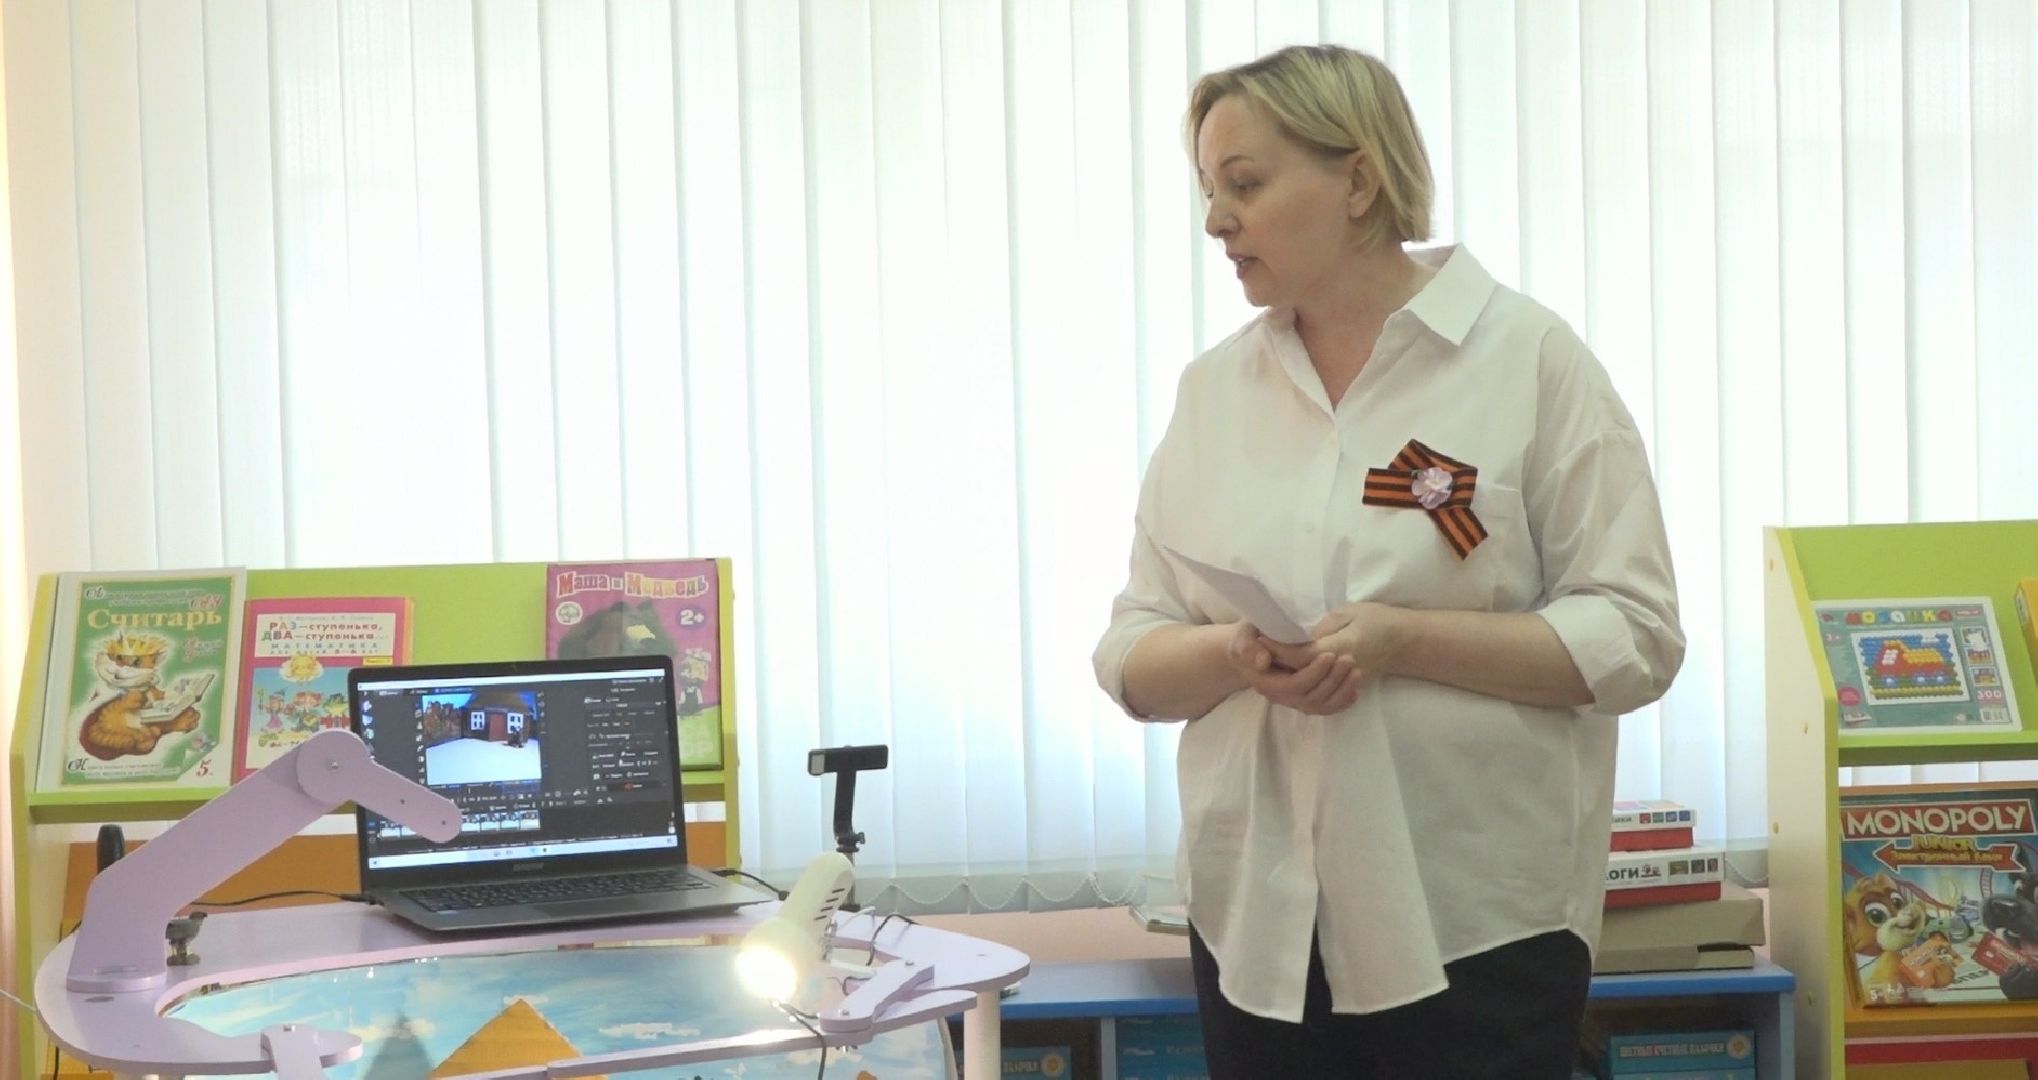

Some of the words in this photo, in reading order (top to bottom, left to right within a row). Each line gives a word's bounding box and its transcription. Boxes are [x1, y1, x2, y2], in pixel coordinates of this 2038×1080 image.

[557, 571, 610, 598] Маша
[624, 572, 709, 599] Медведь
[87, 609, 222, 631] Считарь
[680, 609, 704, 625] 2+
[1847, 805, 2026, 836] MONOPOLY
[1912, 835, 1975, 850] JUNIOR
